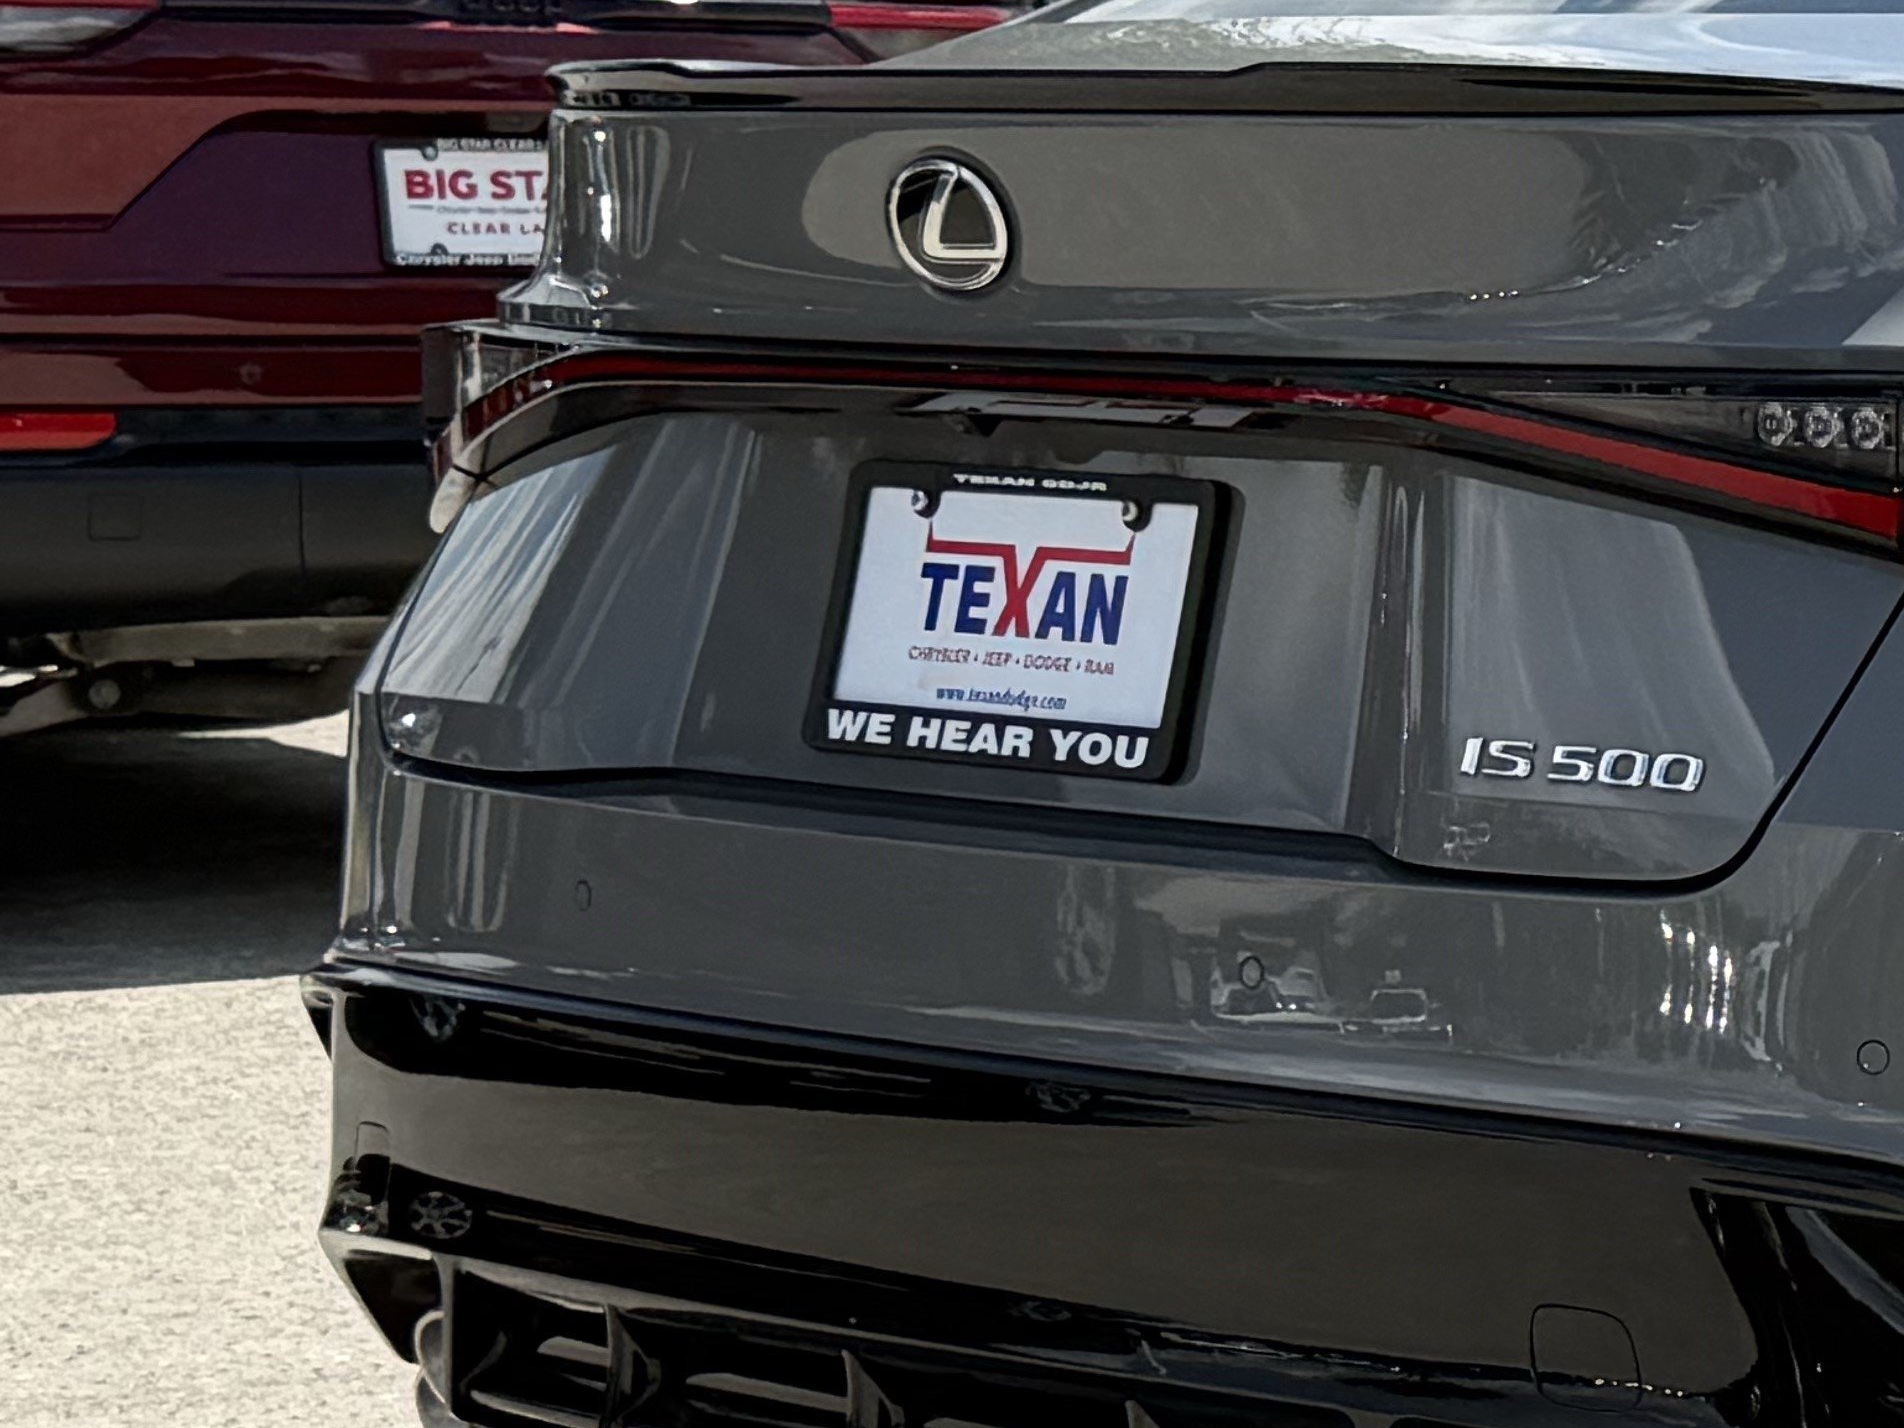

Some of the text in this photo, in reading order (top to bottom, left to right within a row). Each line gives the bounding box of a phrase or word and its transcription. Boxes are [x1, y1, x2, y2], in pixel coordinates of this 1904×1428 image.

[404, 169, 547, 201] BIG ST
[447, 222, 545, 236] CLEAR LA
[953, 473, 1035, 487] TEXAN
[921, 544, 1129, 646] TEXAN
[983, 651, 1013, 667] JEEP
[1024, 654, 1072, 672] DODGE
[827, 708, 1149, 769] WE HEAR YOU
[1460, 737, 1704, 792] IS 500
